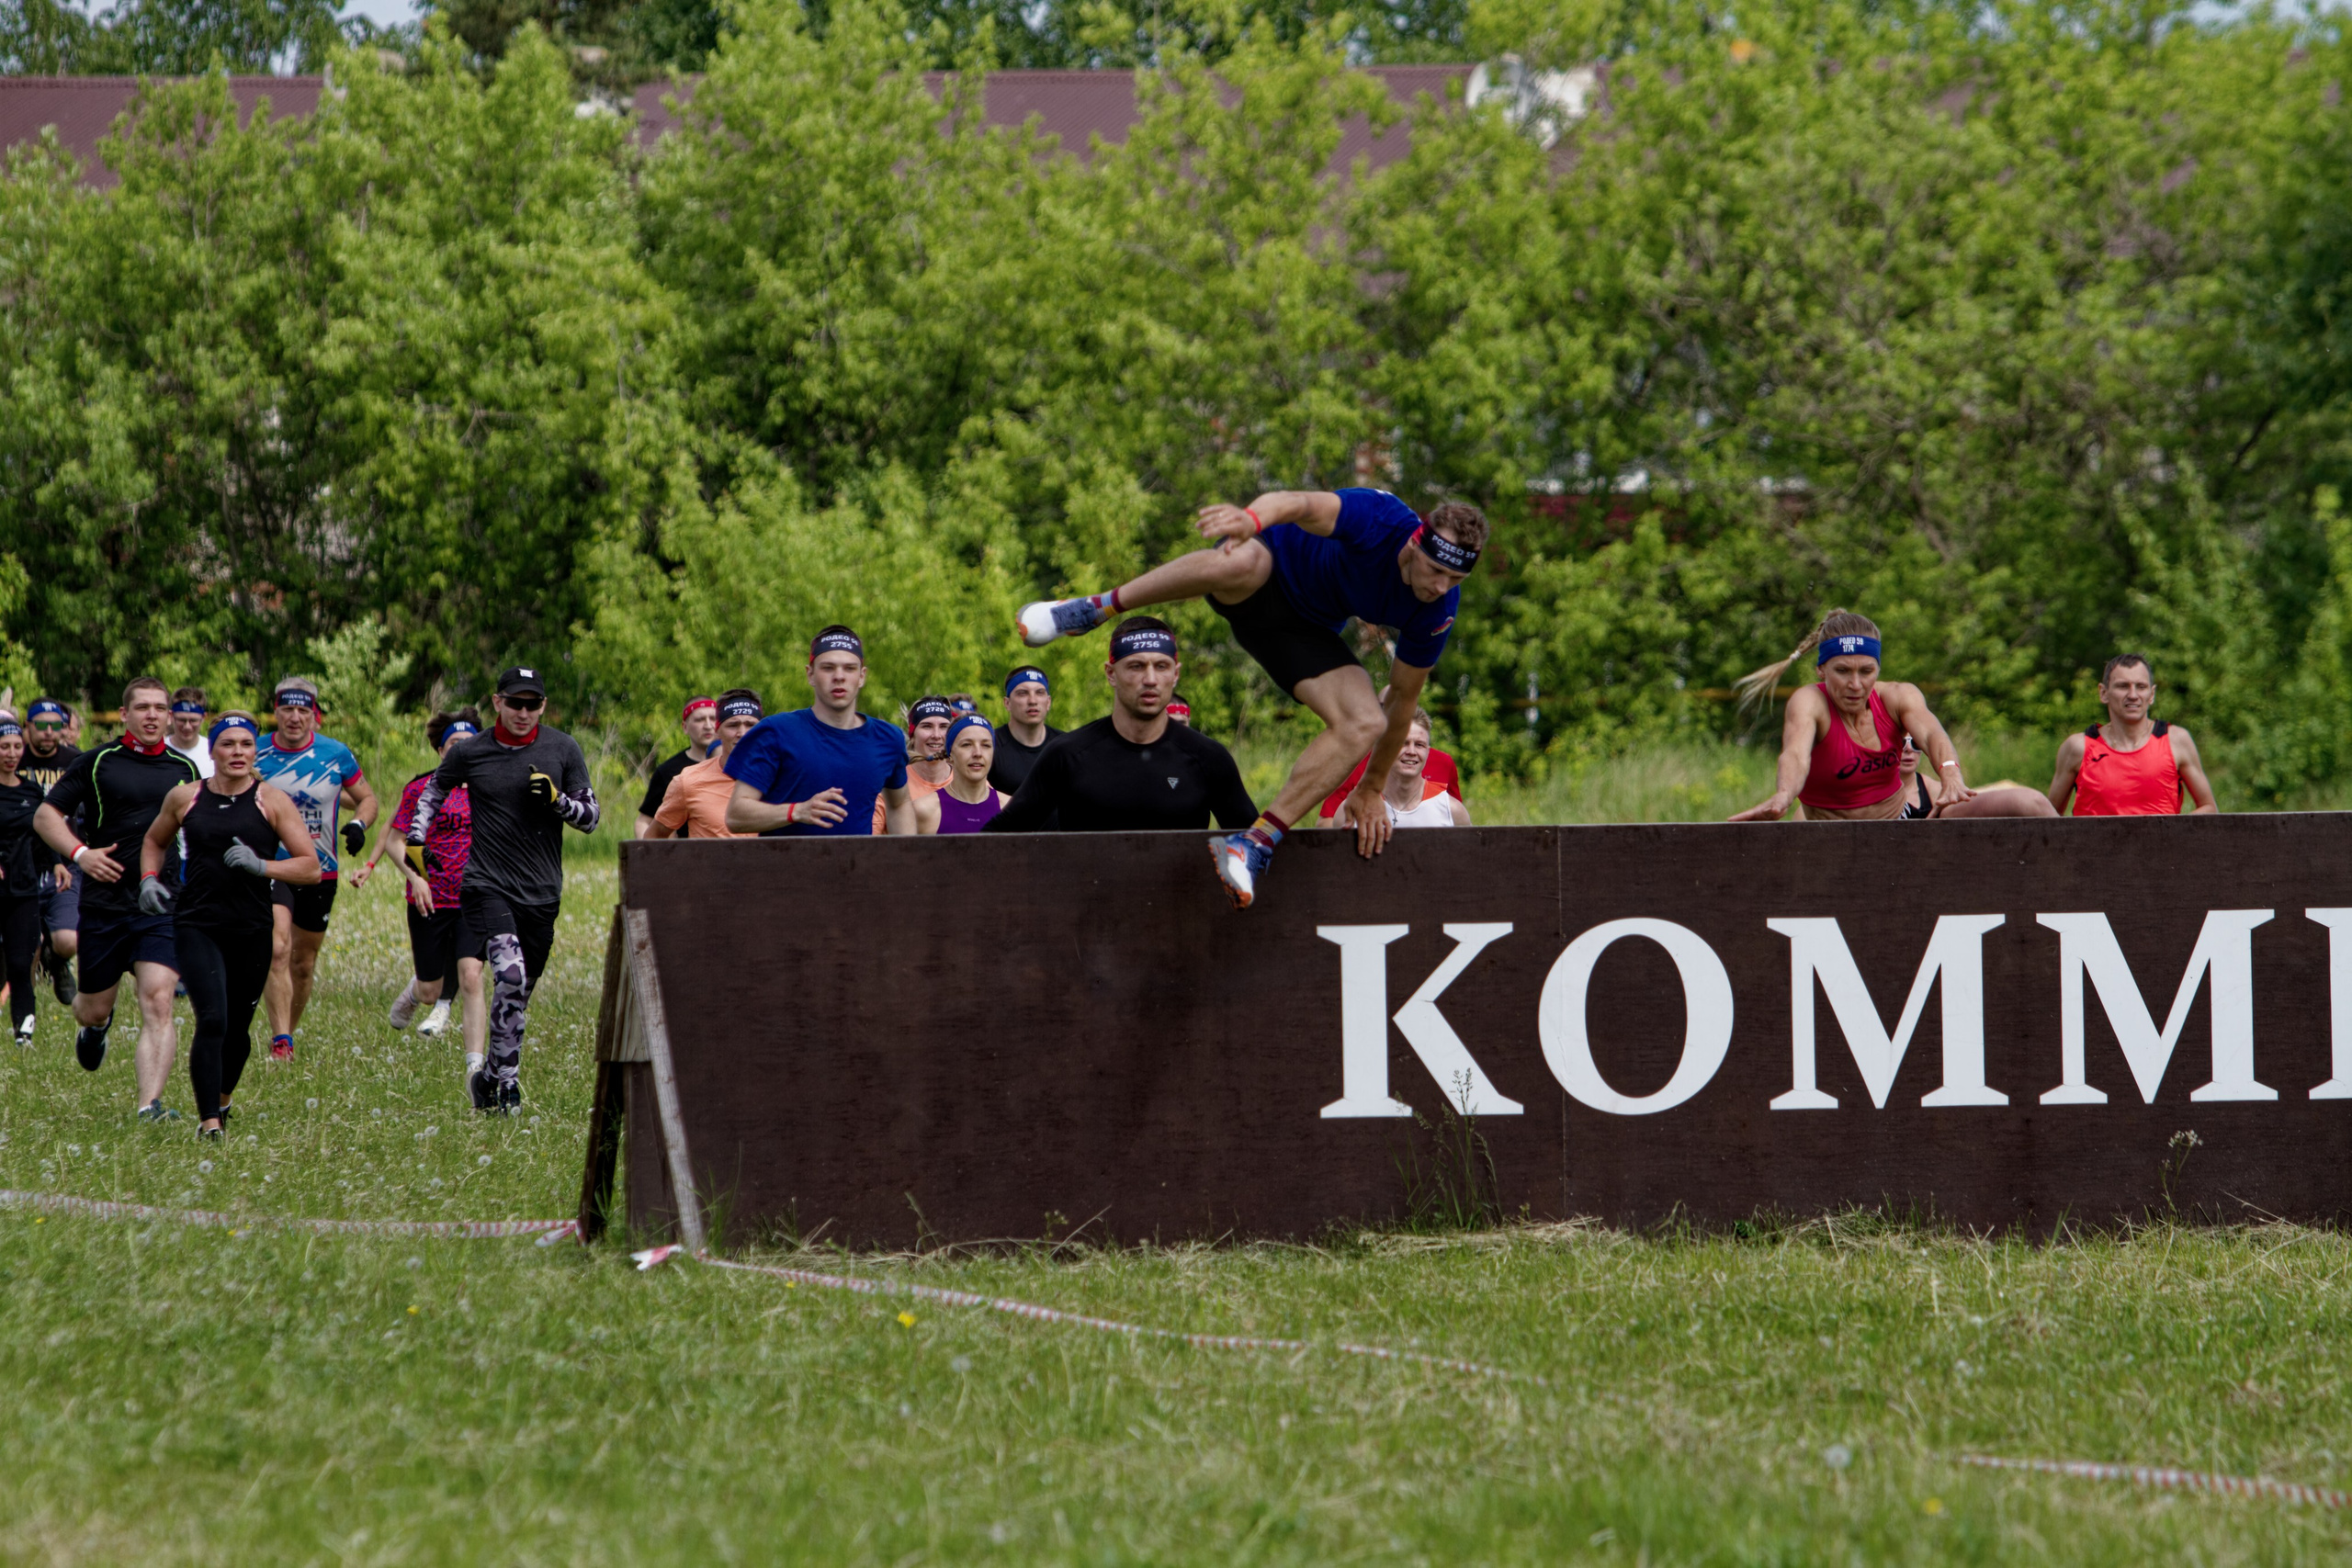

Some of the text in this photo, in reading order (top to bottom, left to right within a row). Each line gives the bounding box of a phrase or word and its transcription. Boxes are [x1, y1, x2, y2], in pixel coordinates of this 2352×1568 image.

[1431, 535, 1464, 556] РОДЕО
[1436, 550, 1463, 566] 2749
[820, 634, 850, 643] РОДЕО
[1121, 632, 1170, 643] РОДЕО 59
[1839, 637, 1864, 646] РОДЕО 59
[830, 641, 853, 650] 2755
[1133, 640, 1160, 649] 2756
[1842, 644, 1855, 653] 1774
[724, 701, 750, 711] РОДЕО
[916, 701, 942, 712] РОДЕО
[732, 707, 753, 716] 2729
[1317, 908, 2352, 1119] КОММ
